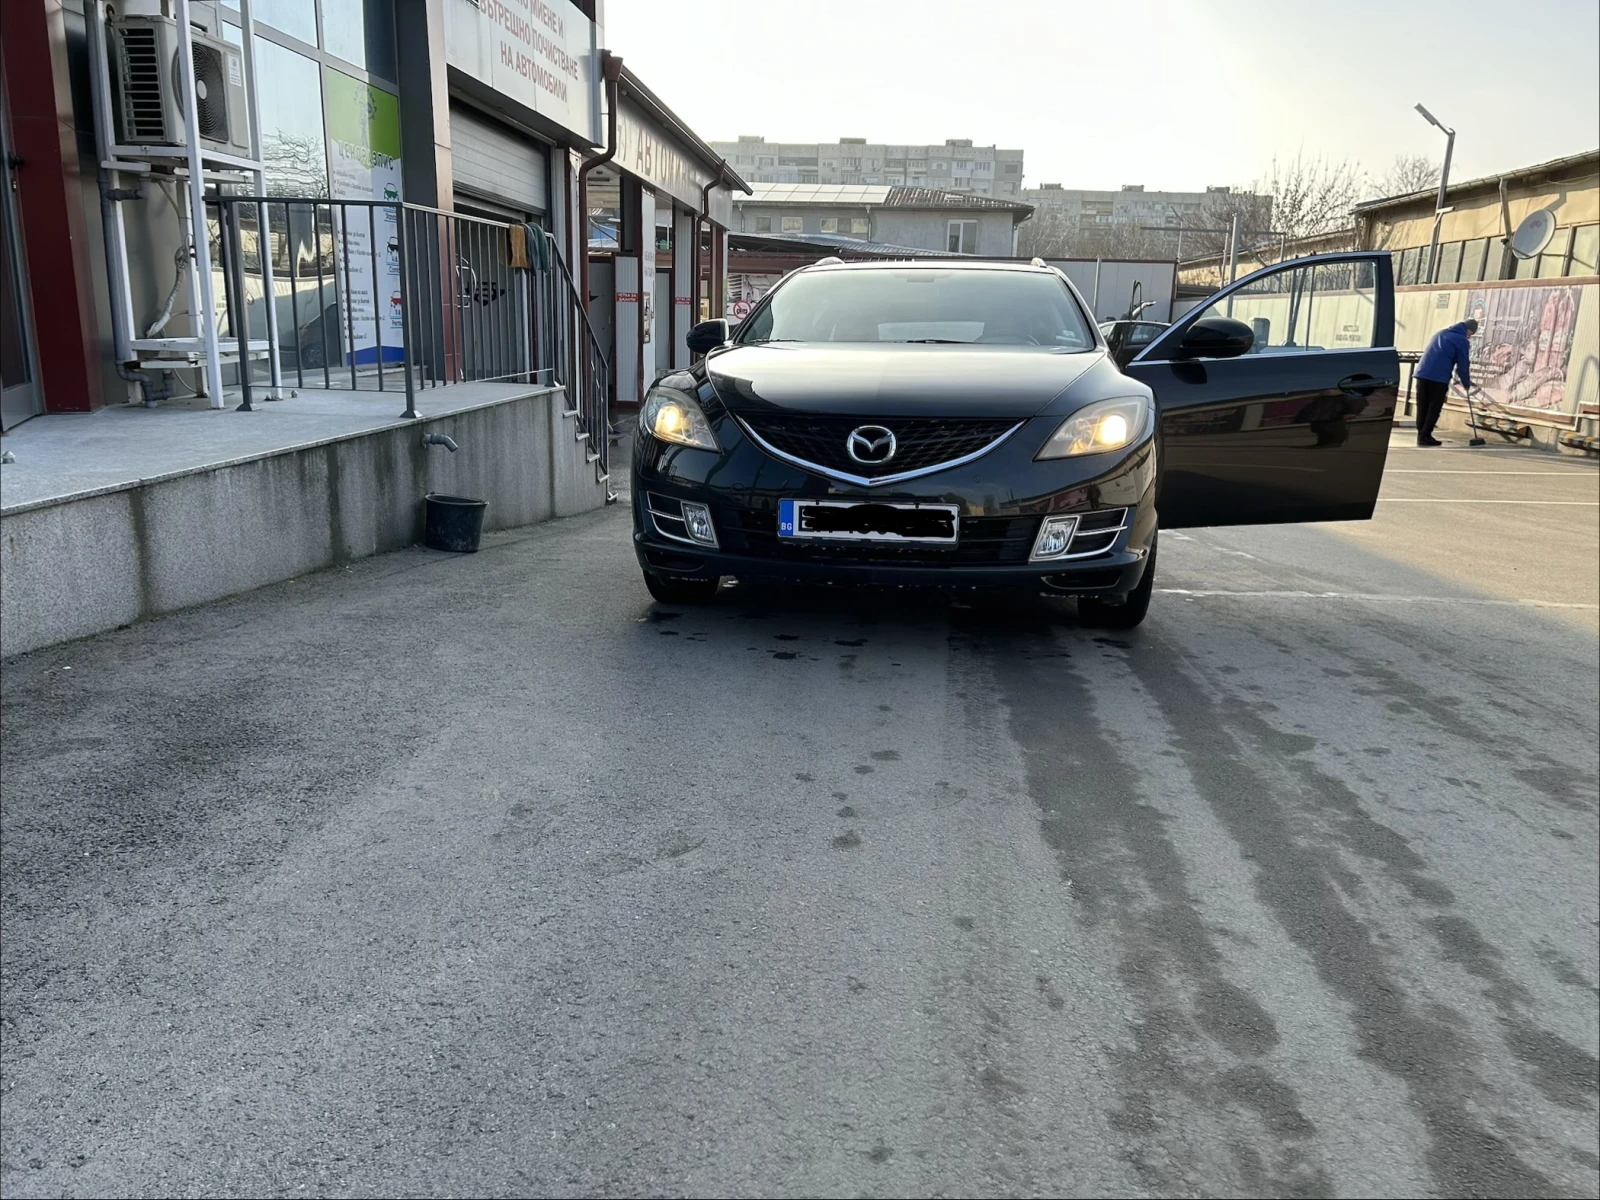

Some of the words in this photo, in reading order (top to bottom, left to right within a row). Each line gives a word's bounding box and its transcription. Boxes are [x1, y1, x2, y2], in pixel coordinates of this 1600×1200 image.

[480, 0, 531, 45] ВЪТРЕШНО
[532, 28, 578, 80] ПОЧИСТВАНЕ
[500, 41, 513, 70] НА
[515, 51, 567, 103] АВТОМОБИЛИ
[781, 522, 792, 531] BG
